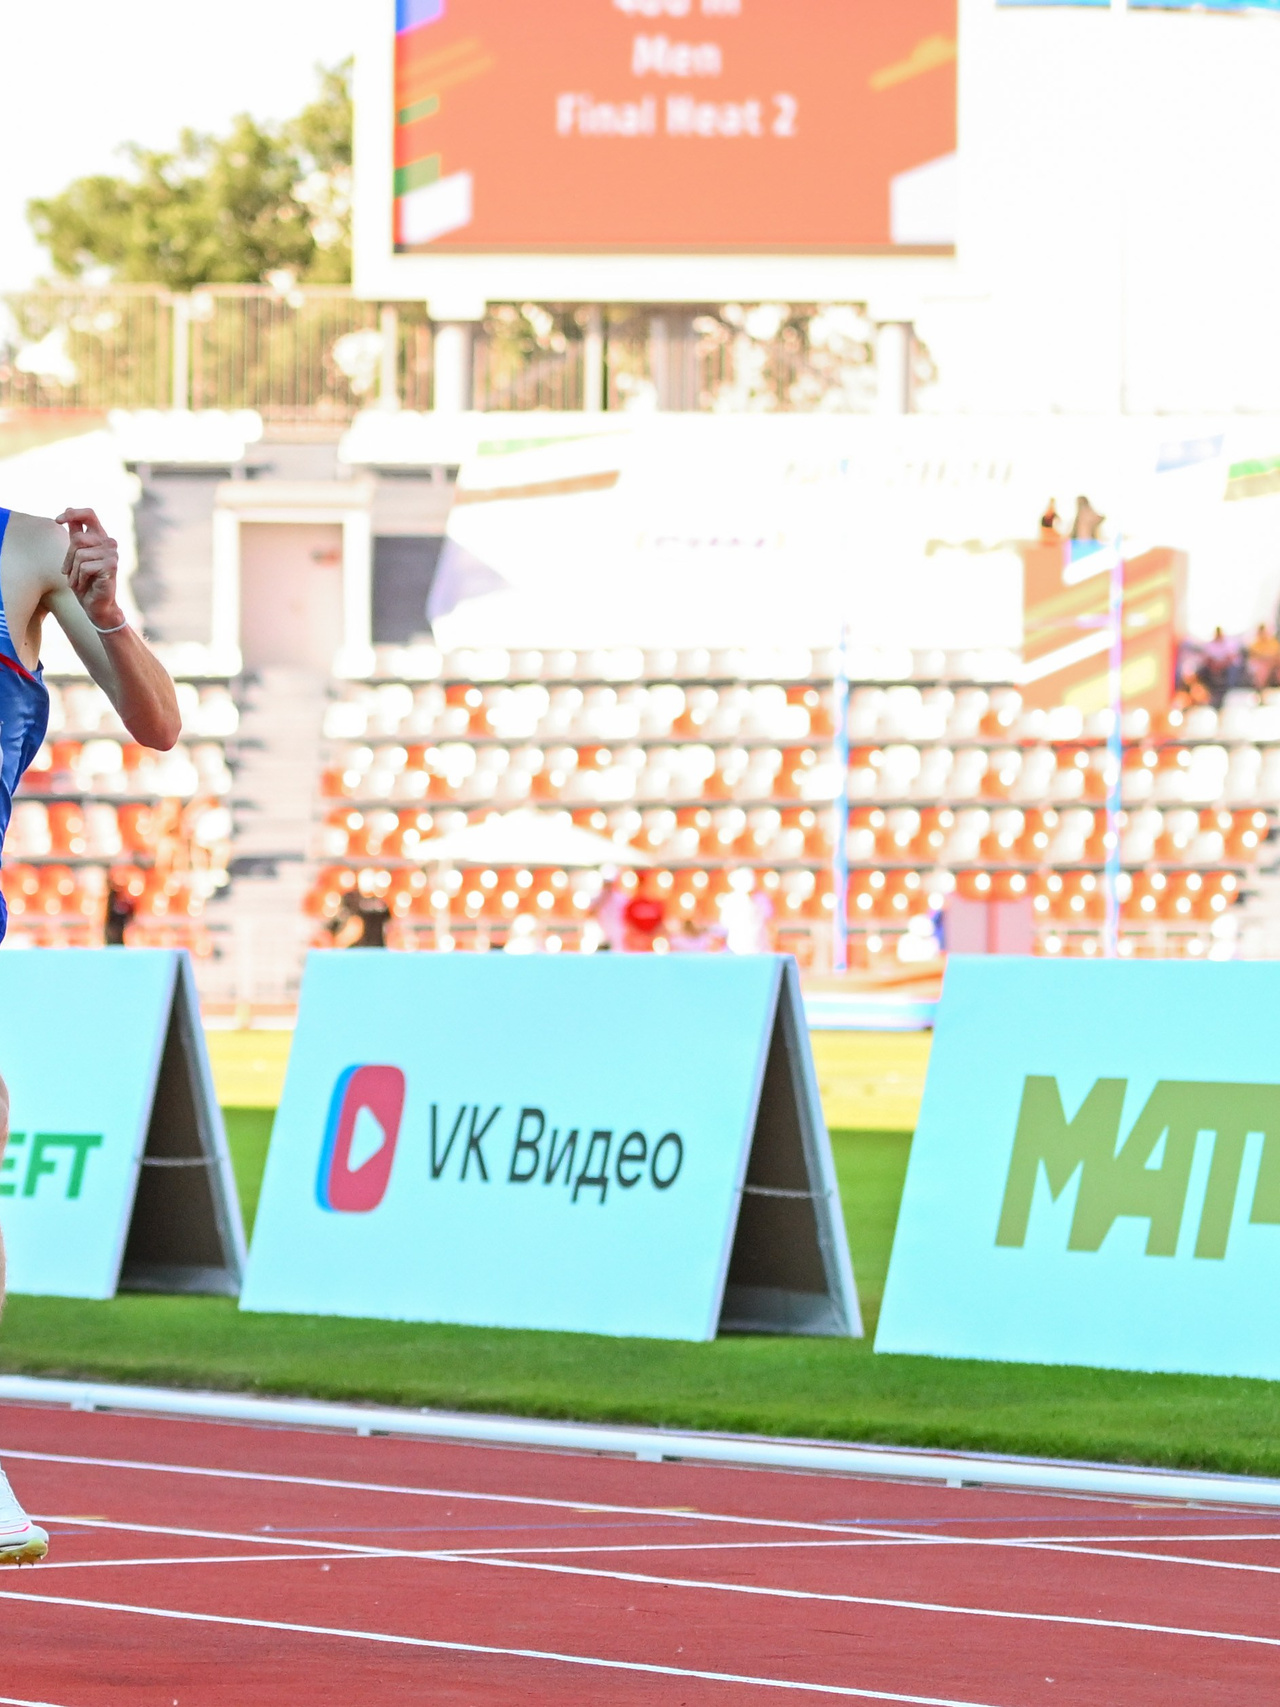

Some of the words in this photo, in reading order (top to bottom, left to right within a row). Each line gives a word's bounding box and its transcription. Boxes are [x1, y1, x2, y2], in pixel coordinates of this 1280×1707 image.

[631, 32, 722, 77] Men
[555, 90, 656, 137] Final
[665, 90, 763, 137] Heat
[771, 90, 799, 138] 2
[428, 1103, 505, 1184] VK
[508, 1107, 686, 1204] Видео
